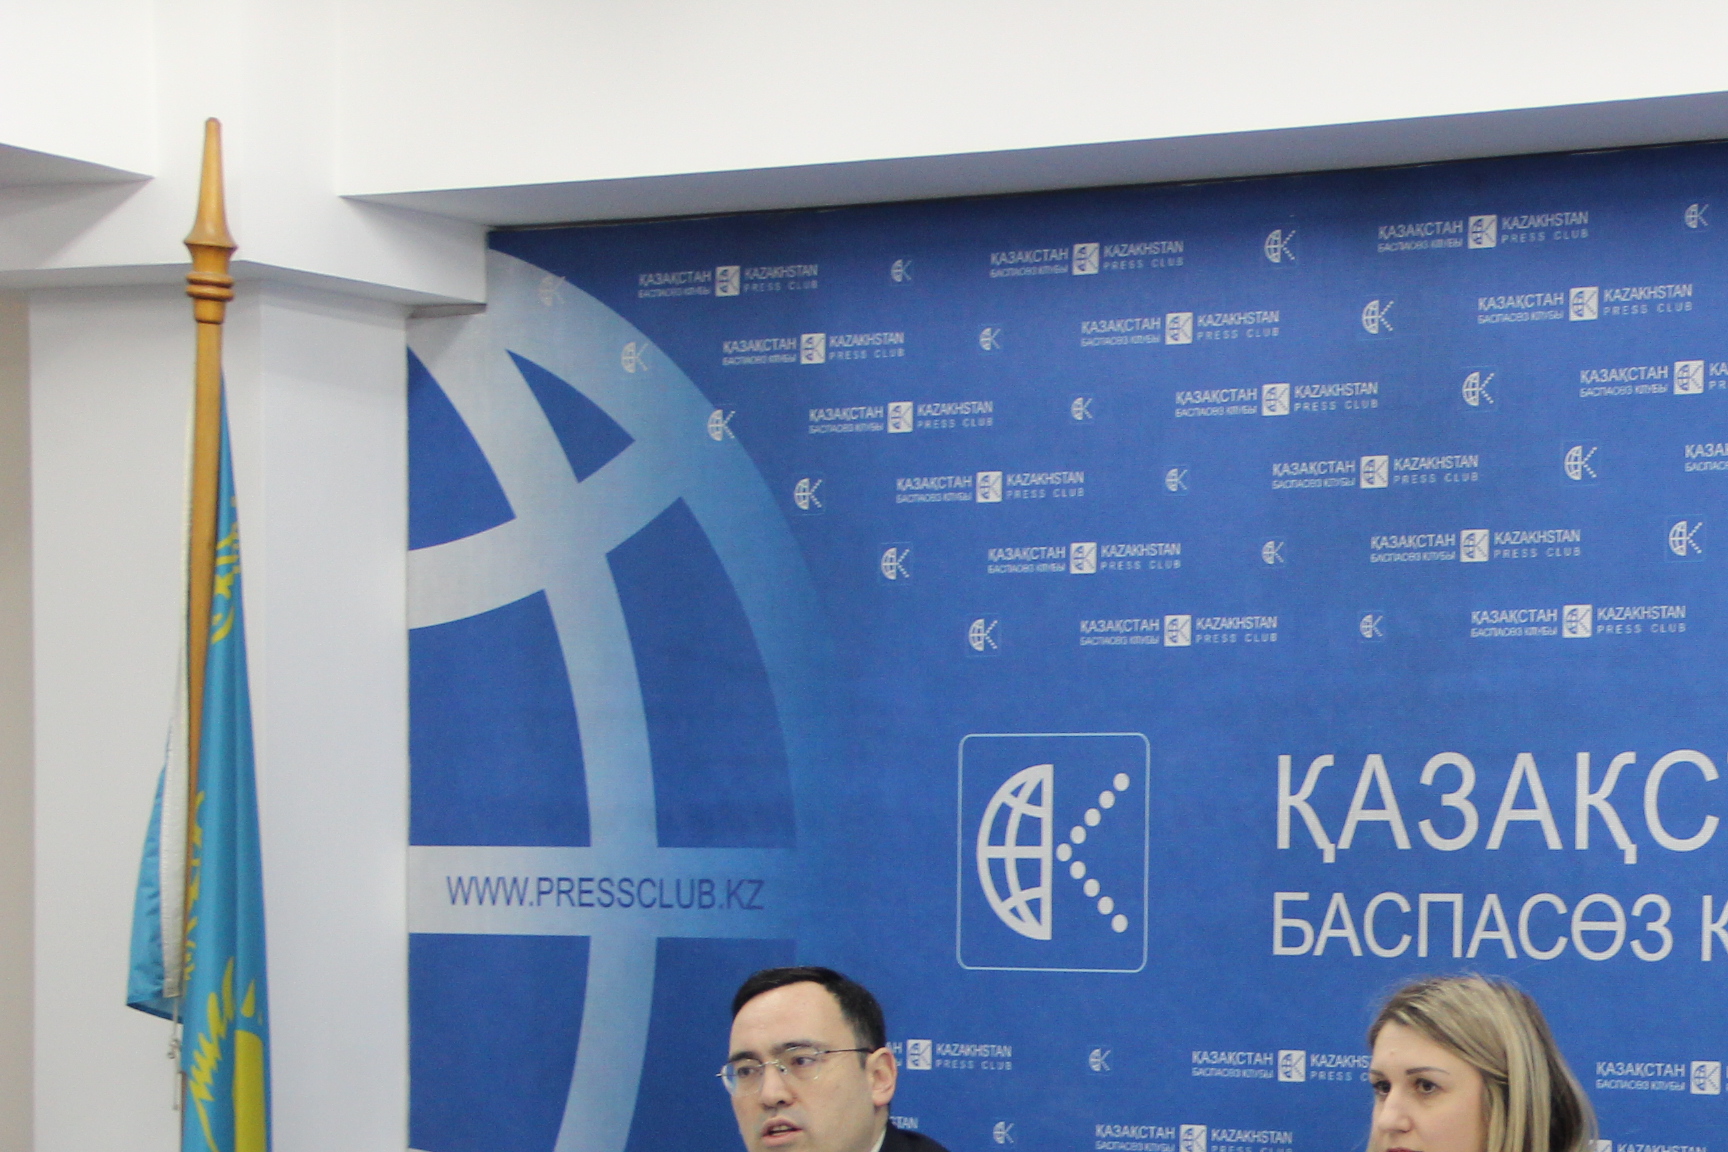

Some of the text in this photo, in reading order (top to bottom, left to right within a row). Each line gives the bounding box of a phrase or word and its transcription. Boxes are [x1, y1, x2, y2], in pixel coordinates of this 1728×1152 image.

[1502, 210, 1589, 230] KAZAKHSTAN
[1103, 239, 1183, 257] KAZAKHSTAN
[744, 264, 817, 280] KAZAKHSTAN
[1603, 283, 1693, 302] KAZAKHSTAN
[1197, 310, 1280, 327] KAZAKHSTAN
[829, 331, 905, 348] KAZAKHSTAN
[1294, 381, 1379, 398] KAZAKHSTAN
[917, 401, 993, 417] KAZAKHSTAN
[1393, 454, 1479, 471] KAZAKHSTAN
[1006, 471, 1085, 486] KAZAKHSTAN
[1494, 529, 1581, 545] KAZAKHSTAN
[1100, 542, 1182, 557] KAZAKHSTAN
[1597, 605, 1686, 620] KAZAKHSTAN
[1195, 615, 1278, 630] KAZAKHSTAN
[446, 875, 765, 911] WWW.PRESSCLUB.KZ
[1272, 891, 1673, 961] БАСПАСӨЗ
[935, 1043, 1012, 1058] KAZAKHSTAN
[1210, 1129, 1293, 1144] KAZAKHSTAN
